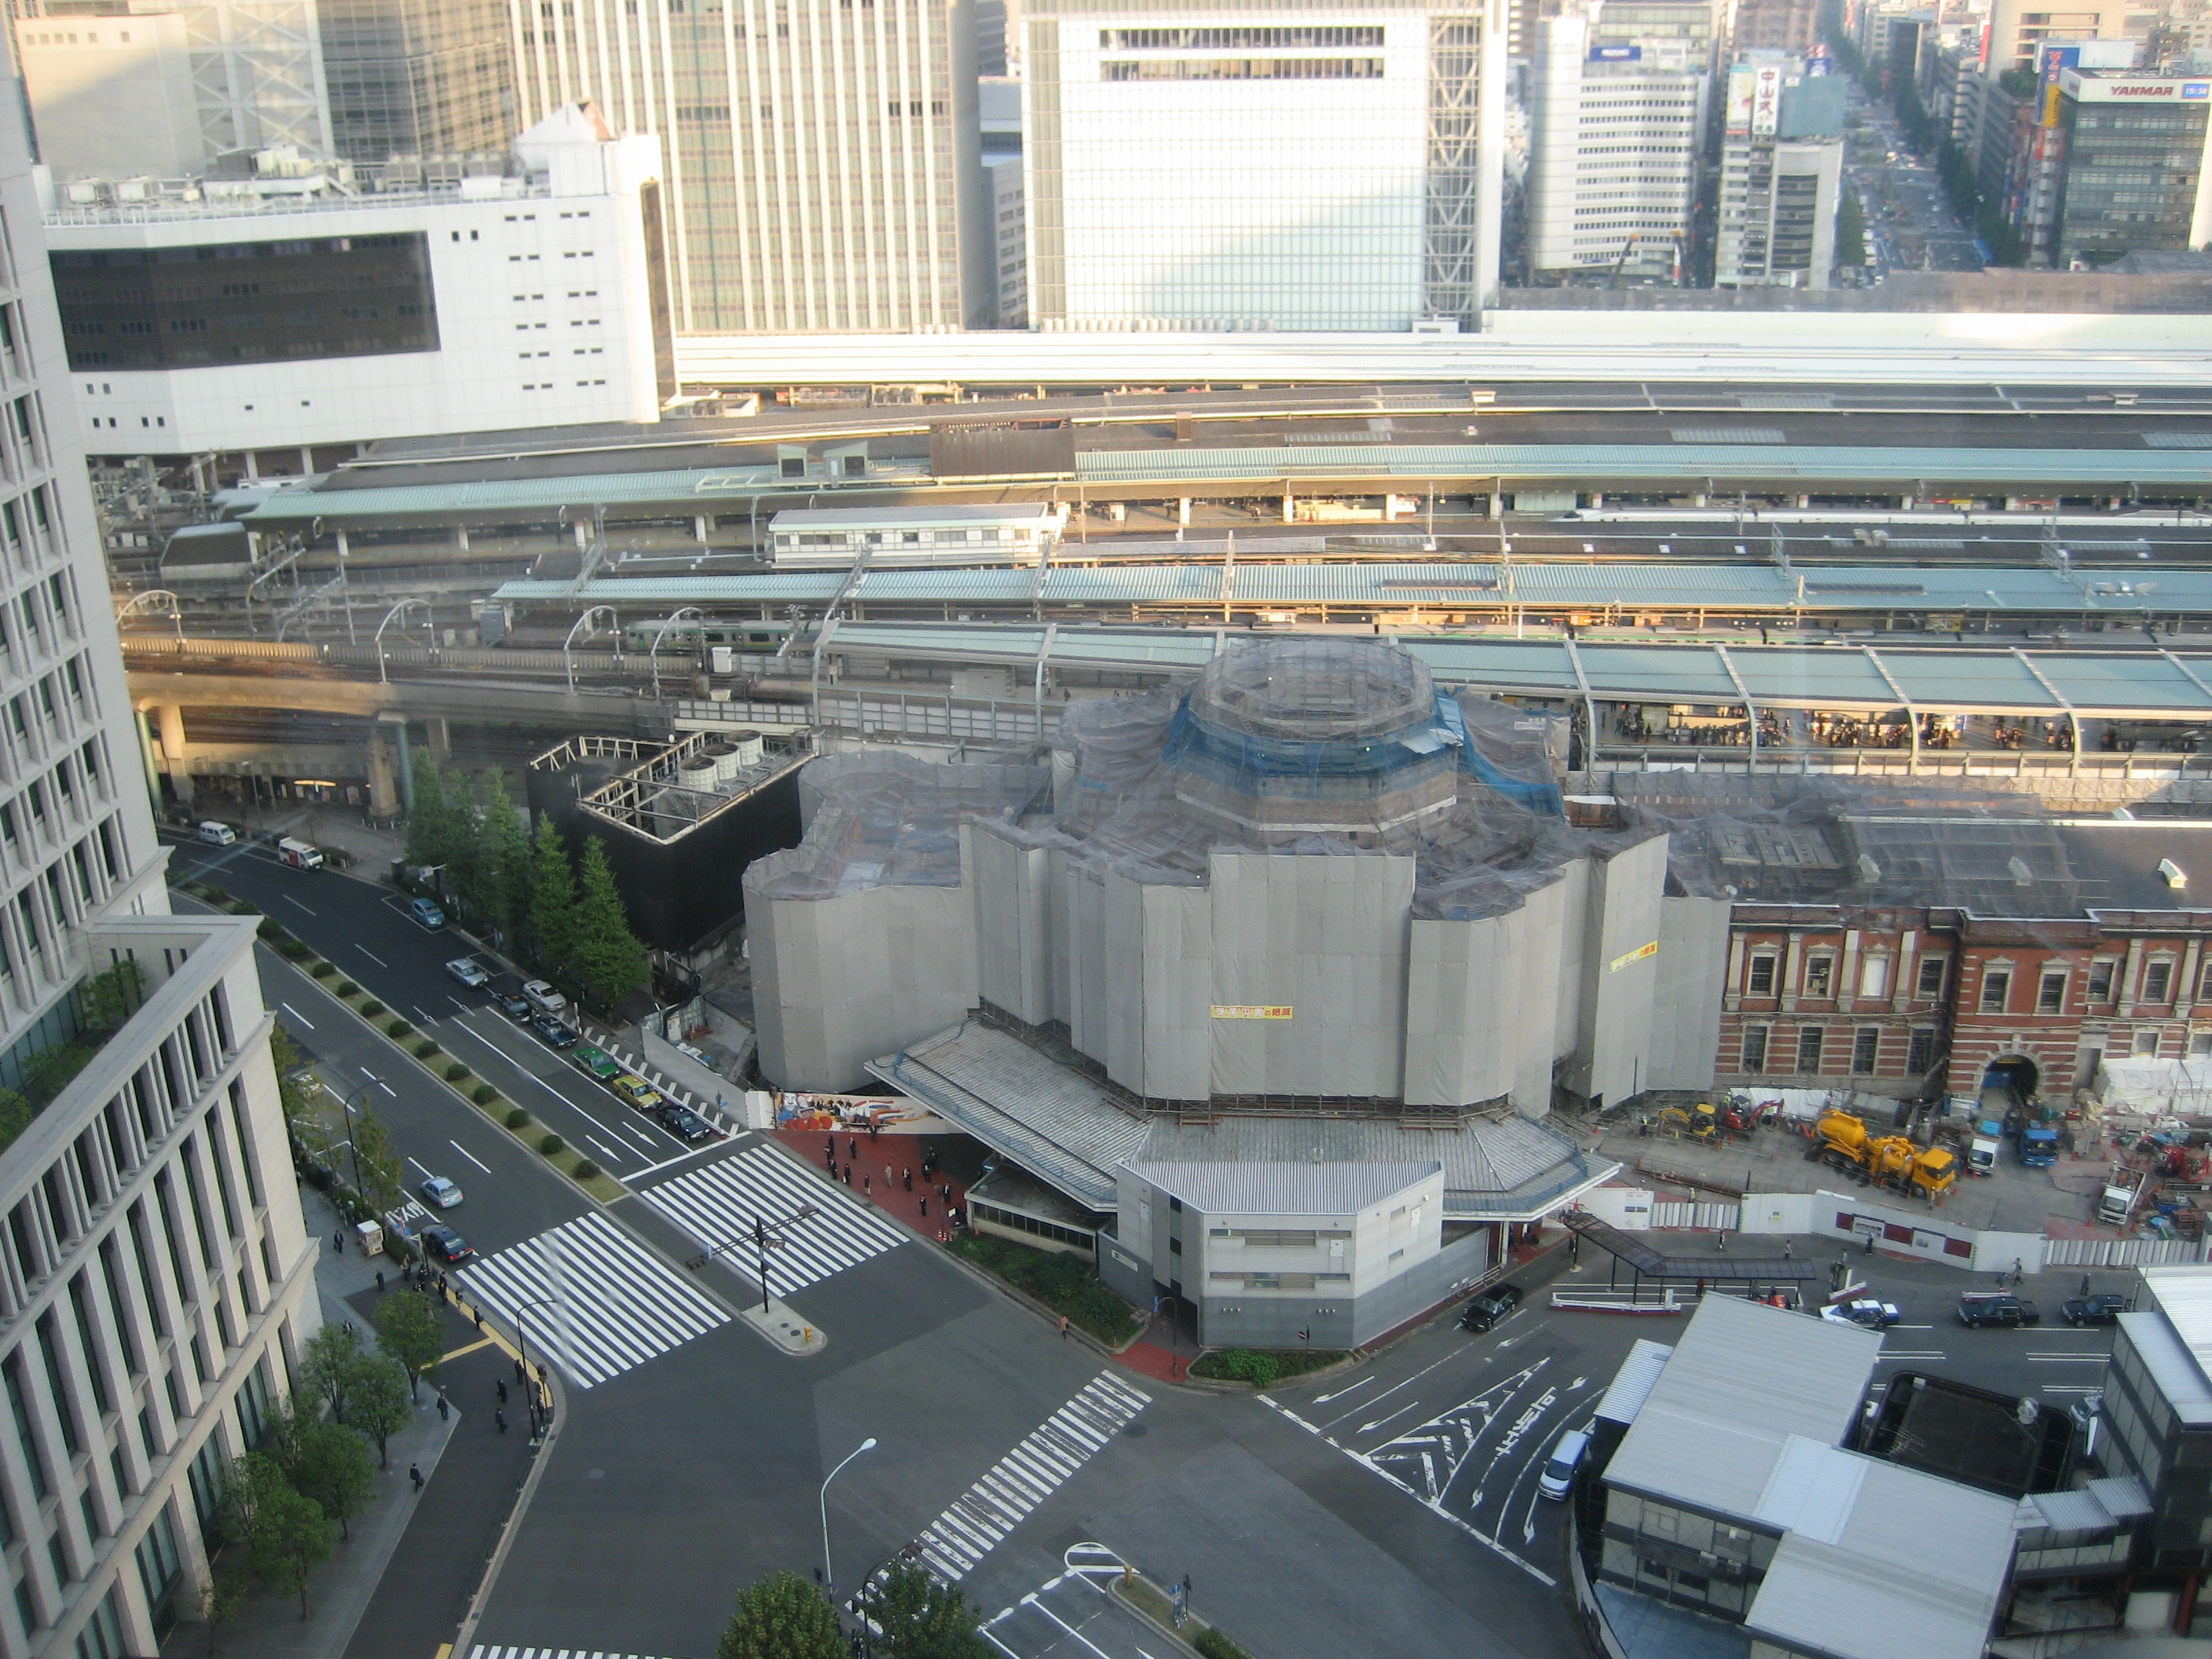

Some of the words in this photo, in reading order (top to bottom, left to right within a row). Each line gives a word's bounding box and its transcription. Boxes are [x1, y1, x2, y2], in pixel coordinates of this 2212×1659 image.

[2111, 86, 2174, 96] YANMAR
[1493, 1386, 1557, 1459] 左折可
